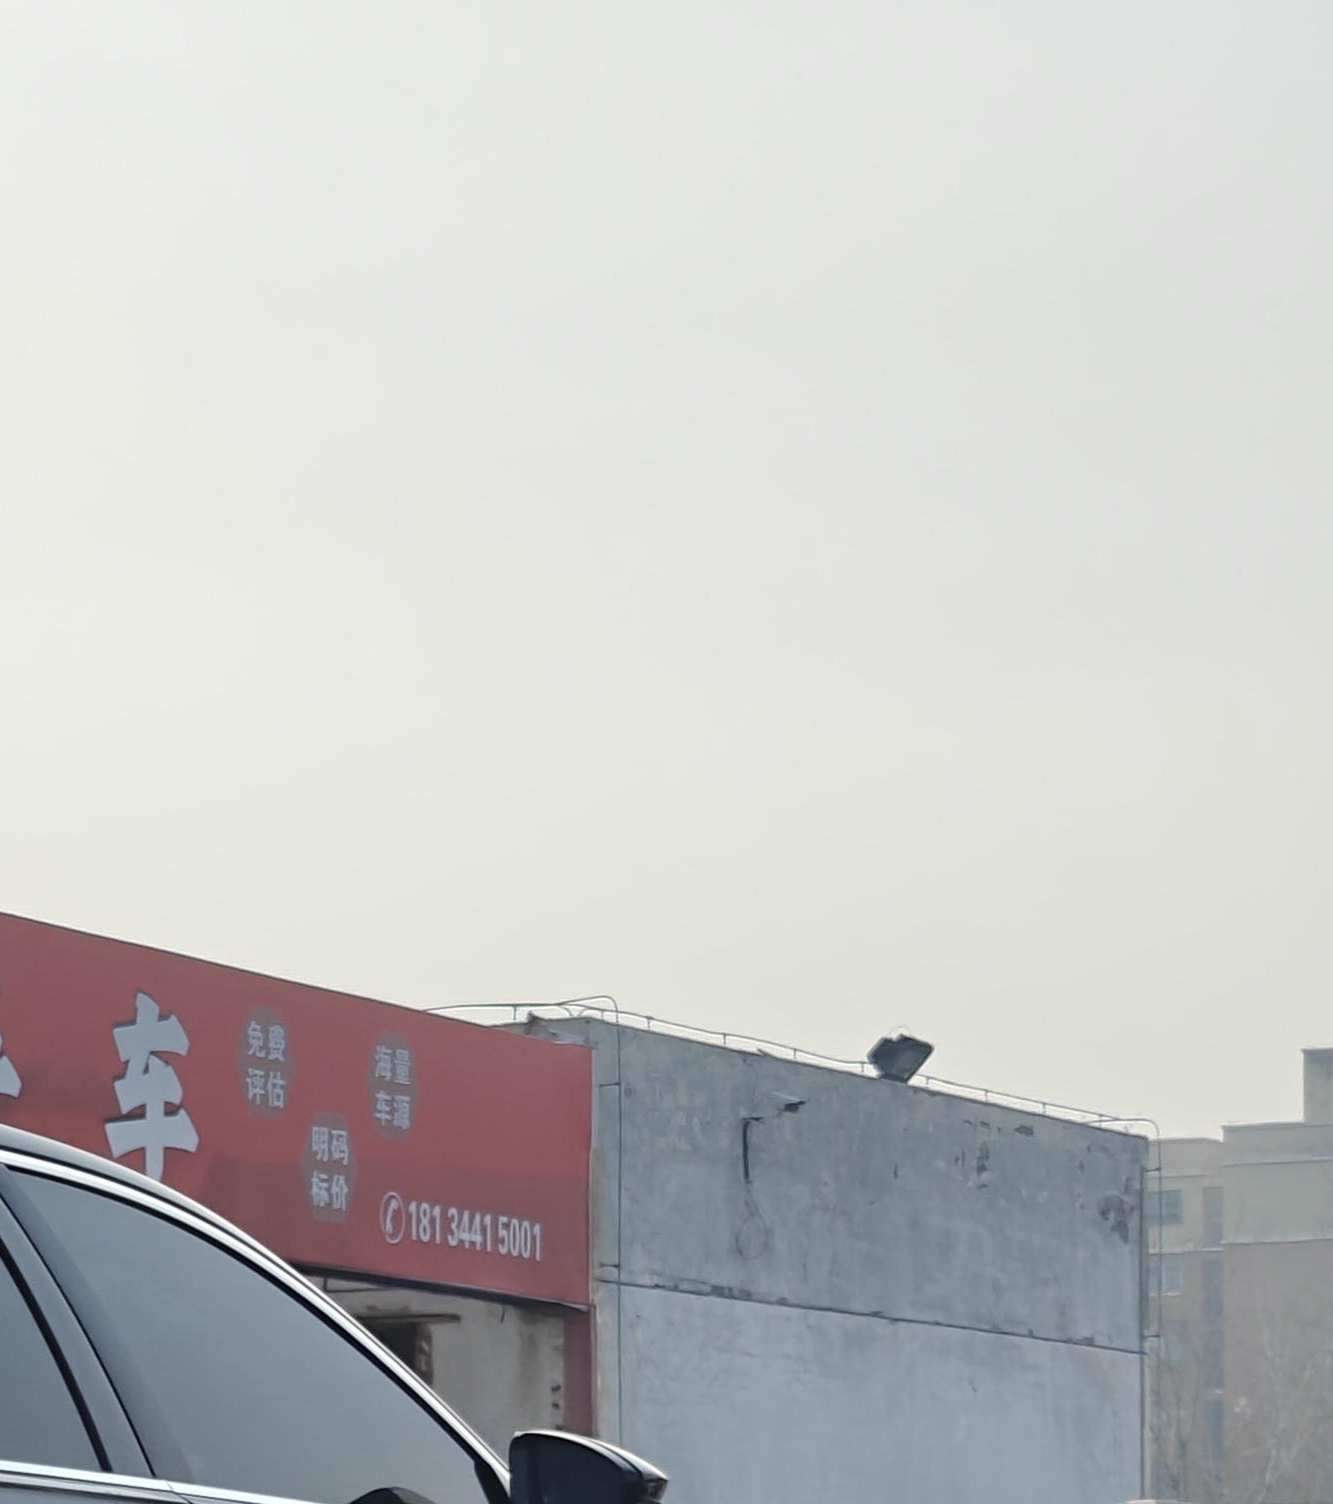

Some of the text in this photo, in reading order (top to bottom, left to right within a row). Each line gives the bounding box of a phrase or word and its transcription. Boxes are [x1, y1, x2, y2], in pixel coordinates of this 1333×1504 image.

[247, 1020, 286, 1062] 免费
[375, 1044, 412, 1085] 海量
[246, 1068, 286, 1109] 评估
[374, 1090, 412, 1130] 车源
[311, 1126, 349, 1165] 明码
[310, 1170, 349, 1211] 标价
[408, 1201, 542, 1262] 181 3441 5001
